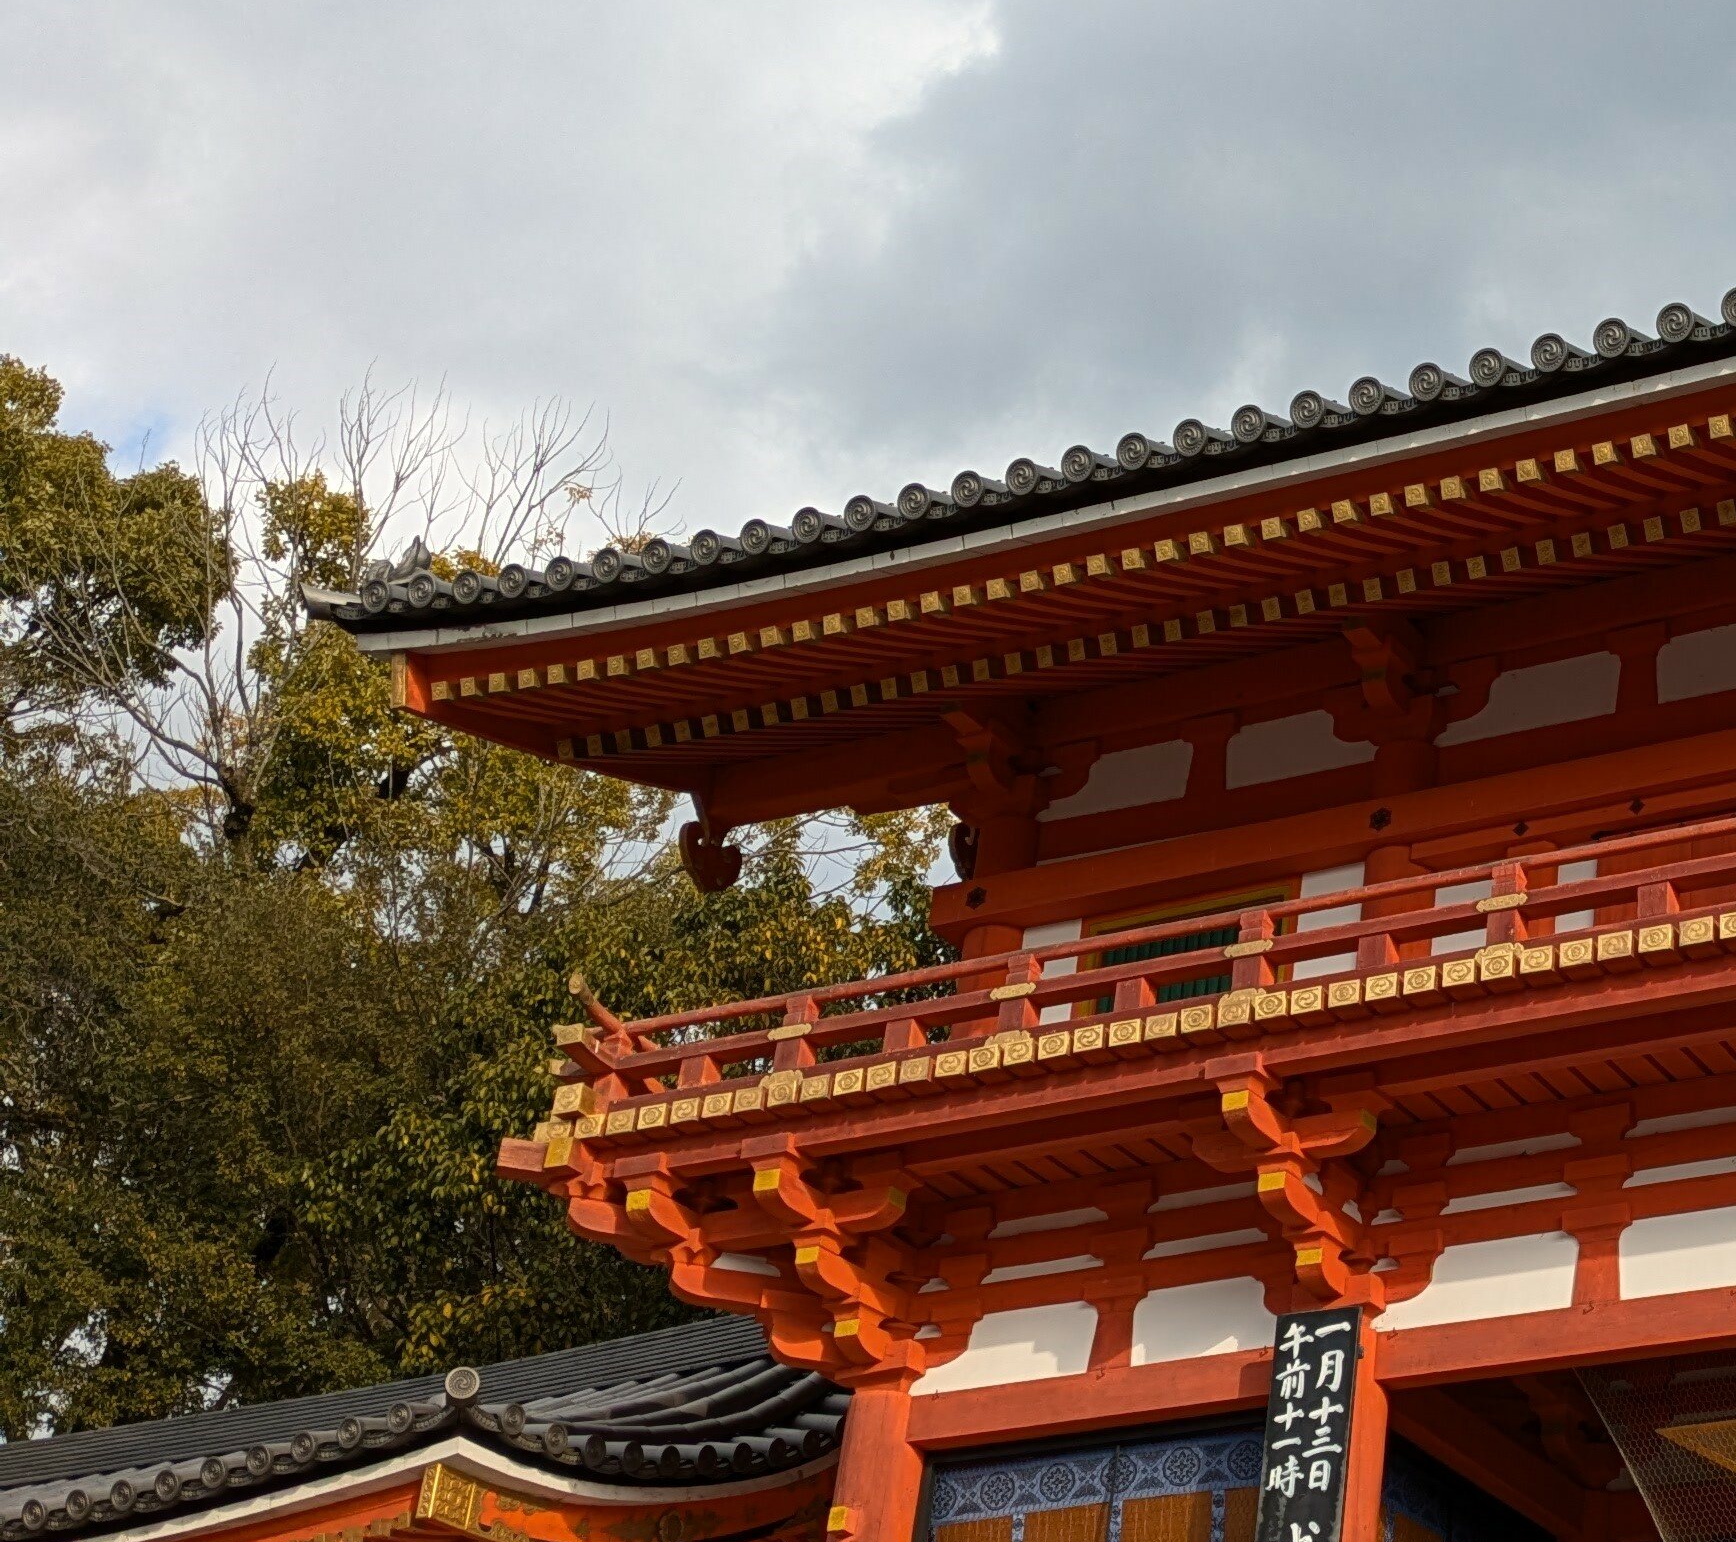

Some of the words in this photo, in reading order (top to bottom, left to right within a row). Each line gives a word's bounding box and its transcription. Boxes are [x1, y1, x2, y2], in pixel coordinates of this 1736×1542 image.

[1265, 1323, 1314, 1499] 午前十一時
[1302, 1320, 1352, 1493] 一月十三日
